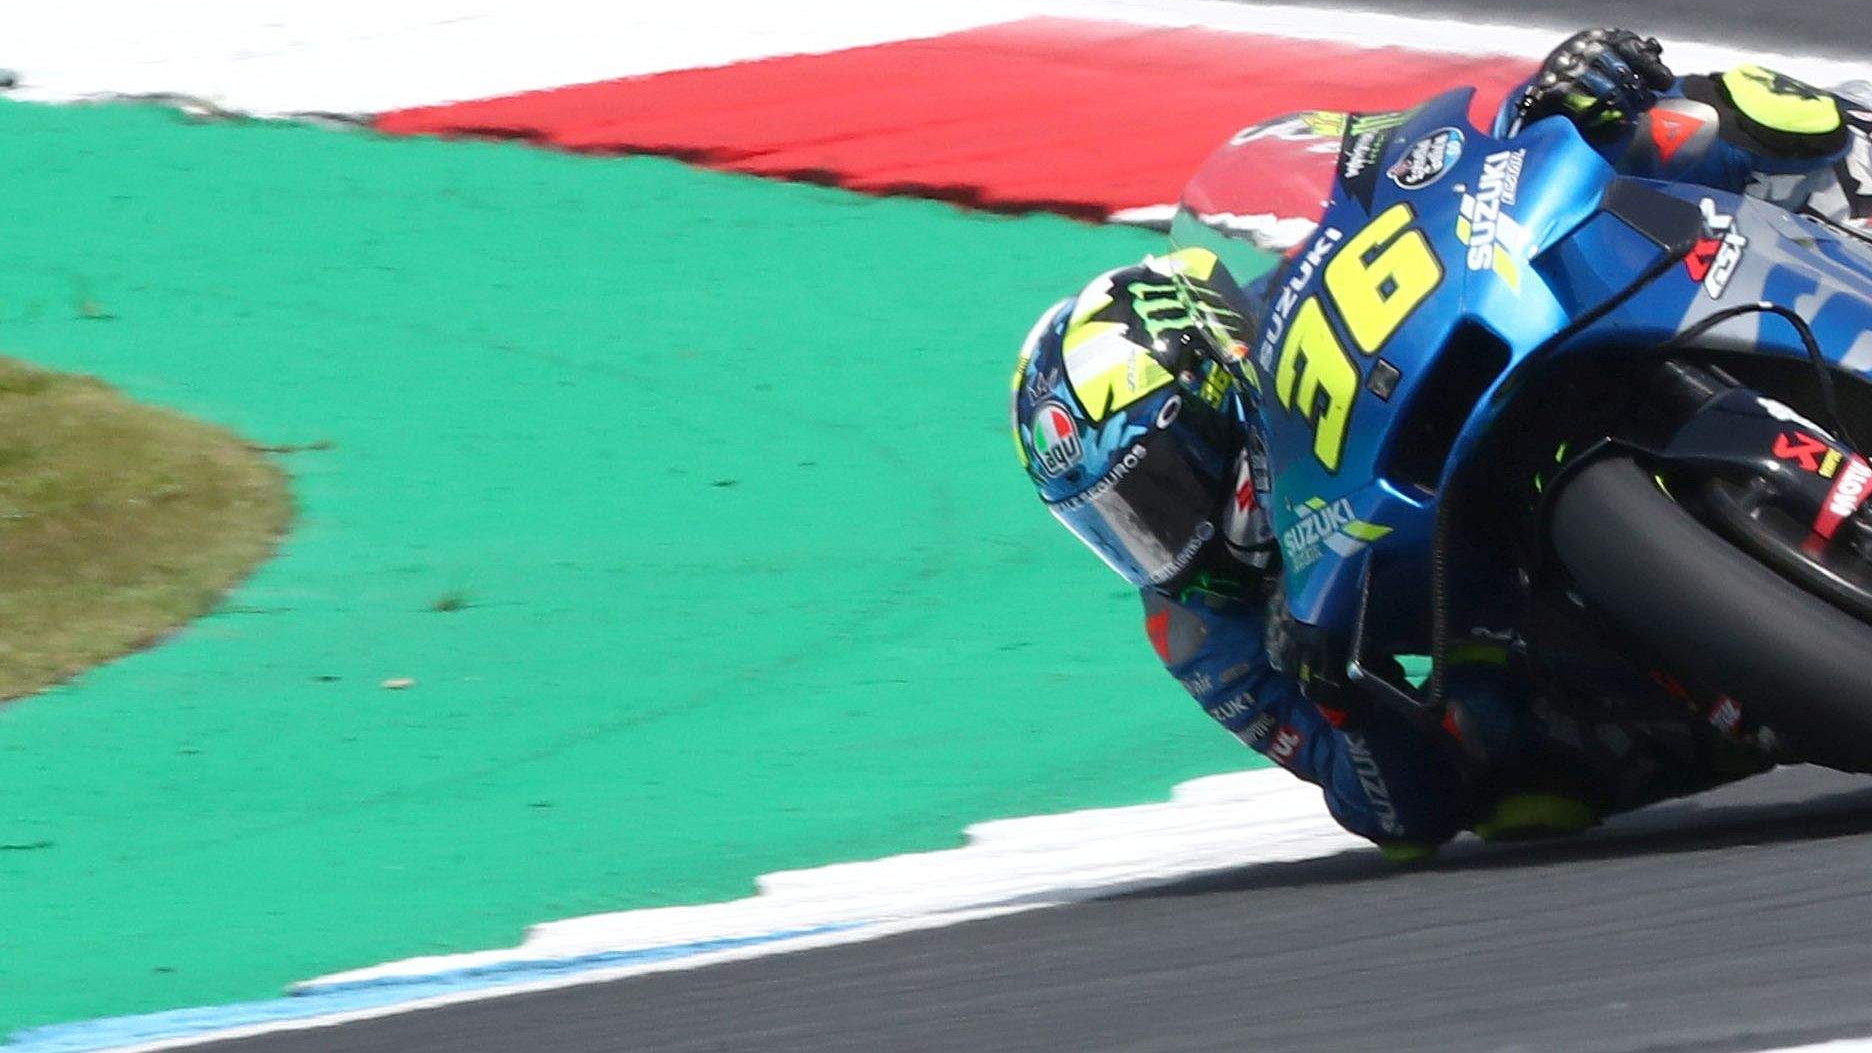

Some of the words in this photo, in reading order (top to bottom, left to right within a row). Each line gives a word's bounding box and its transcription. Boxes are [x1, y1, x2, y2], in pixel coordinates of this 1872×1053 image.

[1467, 150, 1512, 271] SUZUKI
[1259, 227, 1343, 373] SUZUKI
[1275, 202, 1444, 473] 36
[1283, 498, 1356, 558] SUZUKI
